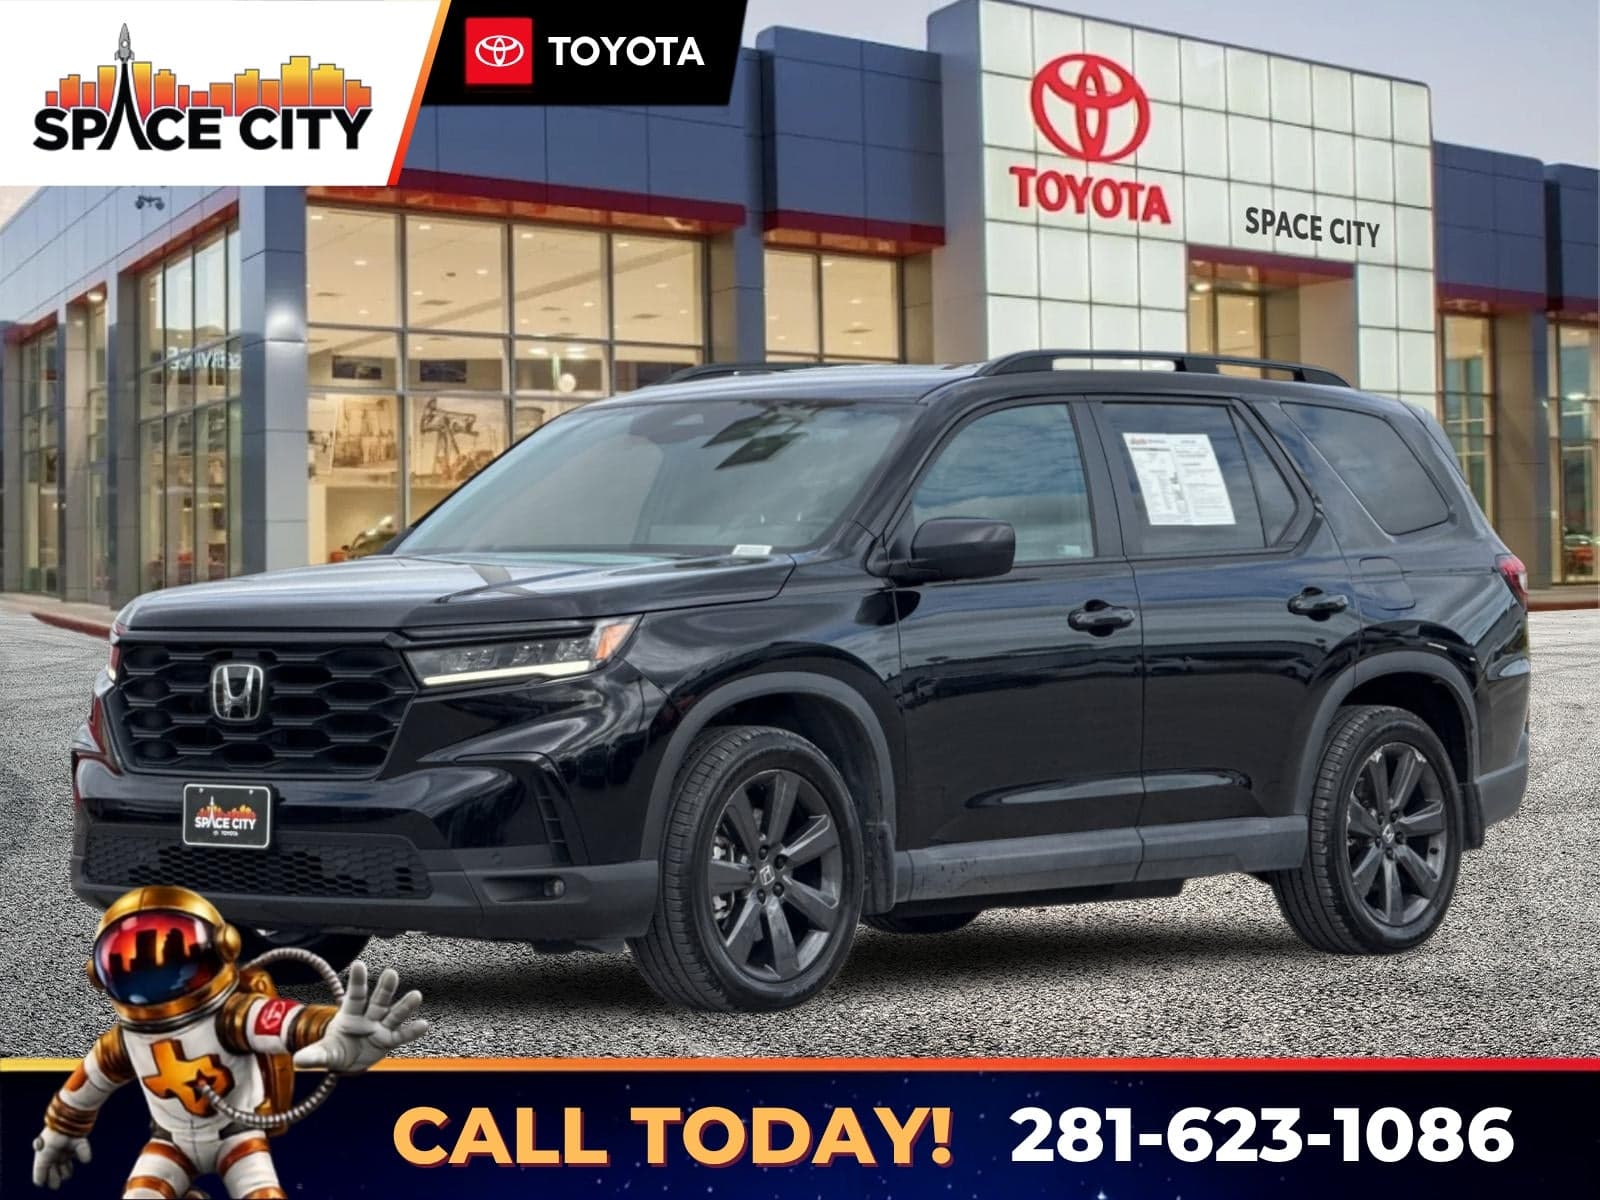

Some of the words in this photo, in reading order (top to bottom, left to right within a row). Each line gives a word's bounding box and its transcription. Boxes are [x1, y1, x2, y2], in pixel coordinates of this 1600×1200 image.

[1009, 166, 1171, 224] TOYOTA
[1245, 206, 1323, 242] SPACE
[1329, 217, 1381, 249] CITY
[194, 816, 230, 829] SPACE
[231, 818, 257, 831] CITY
